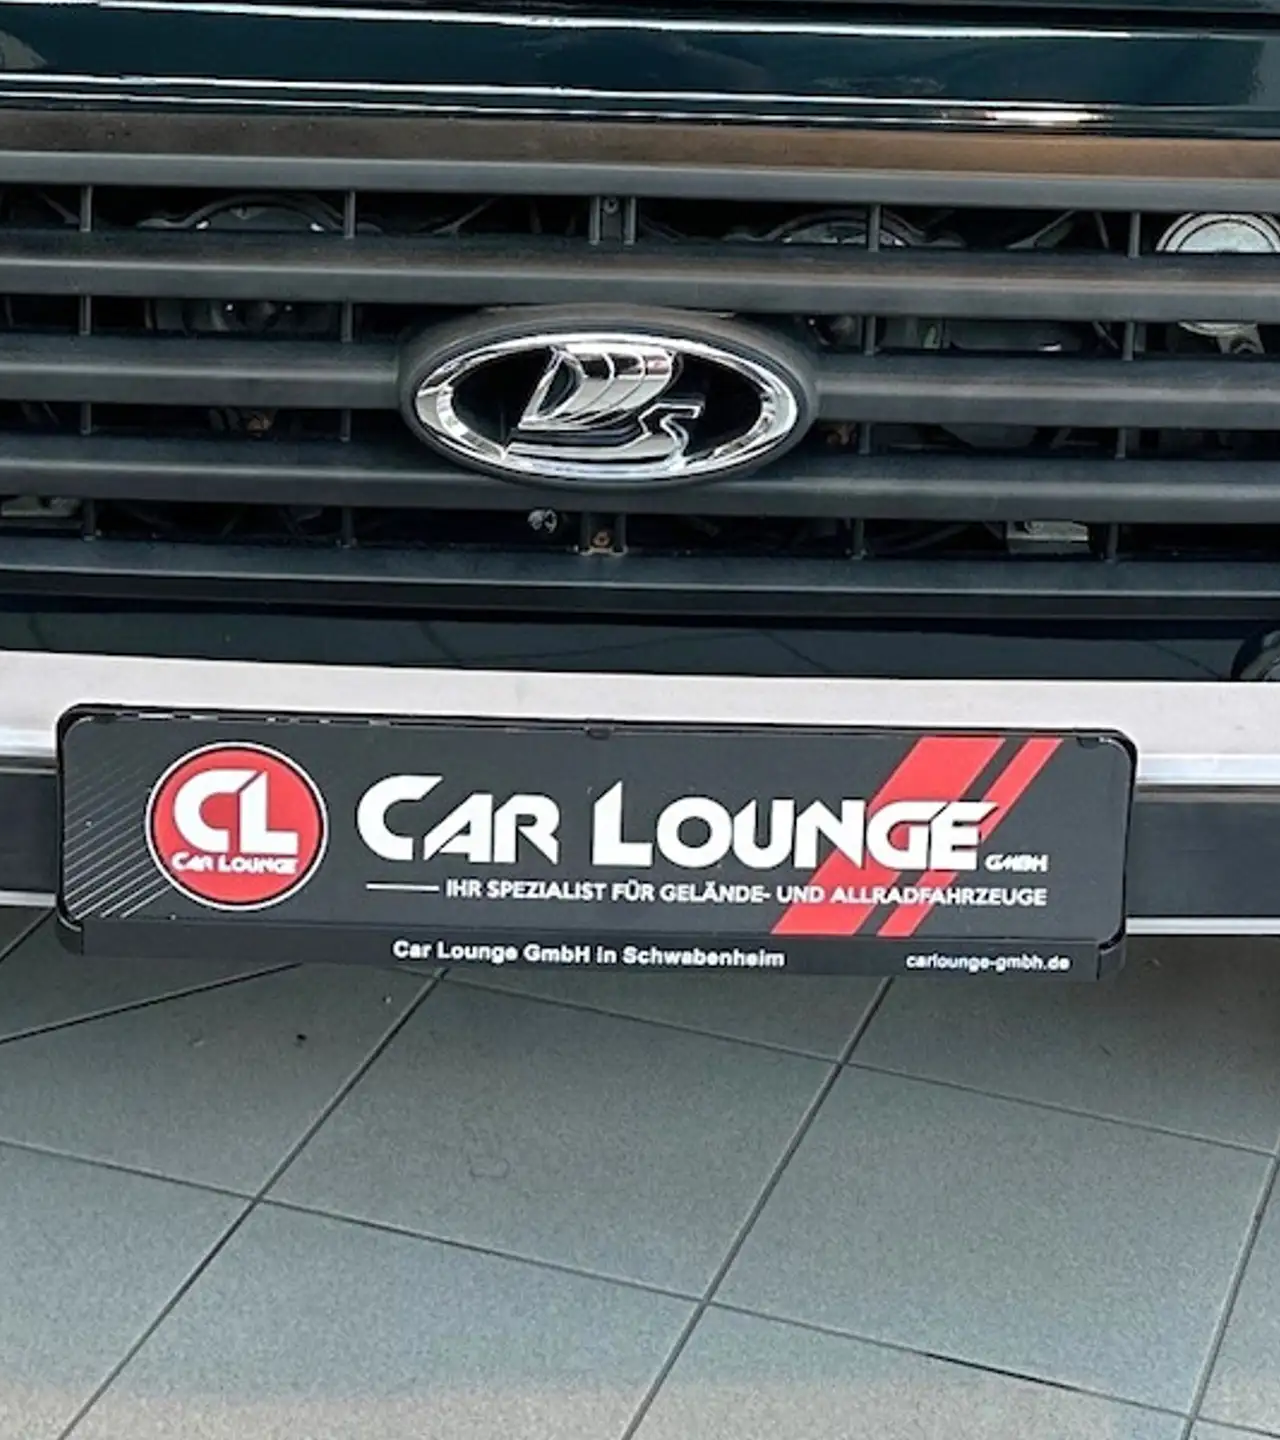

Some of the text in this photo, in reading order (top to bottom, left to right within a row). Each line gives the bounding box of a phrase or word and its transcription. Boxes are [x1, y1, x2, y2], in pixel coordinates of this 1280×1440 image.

[173, 768, 299, 854] CL
[357, 773, 999, 871] CAR LOUNGE
[171, 851, 300, 875] CAR LOUNGE
[446, 878, 1047, 907] IHR SPEZIALIST FÜR GELÄNDE- UND ALLRADFAHRZEUGE
[392, 940, 786, 967] Car Lounge GmbH in Schwabenheim
[905, 951, 1071, 973] carlounge-gmbh.de
